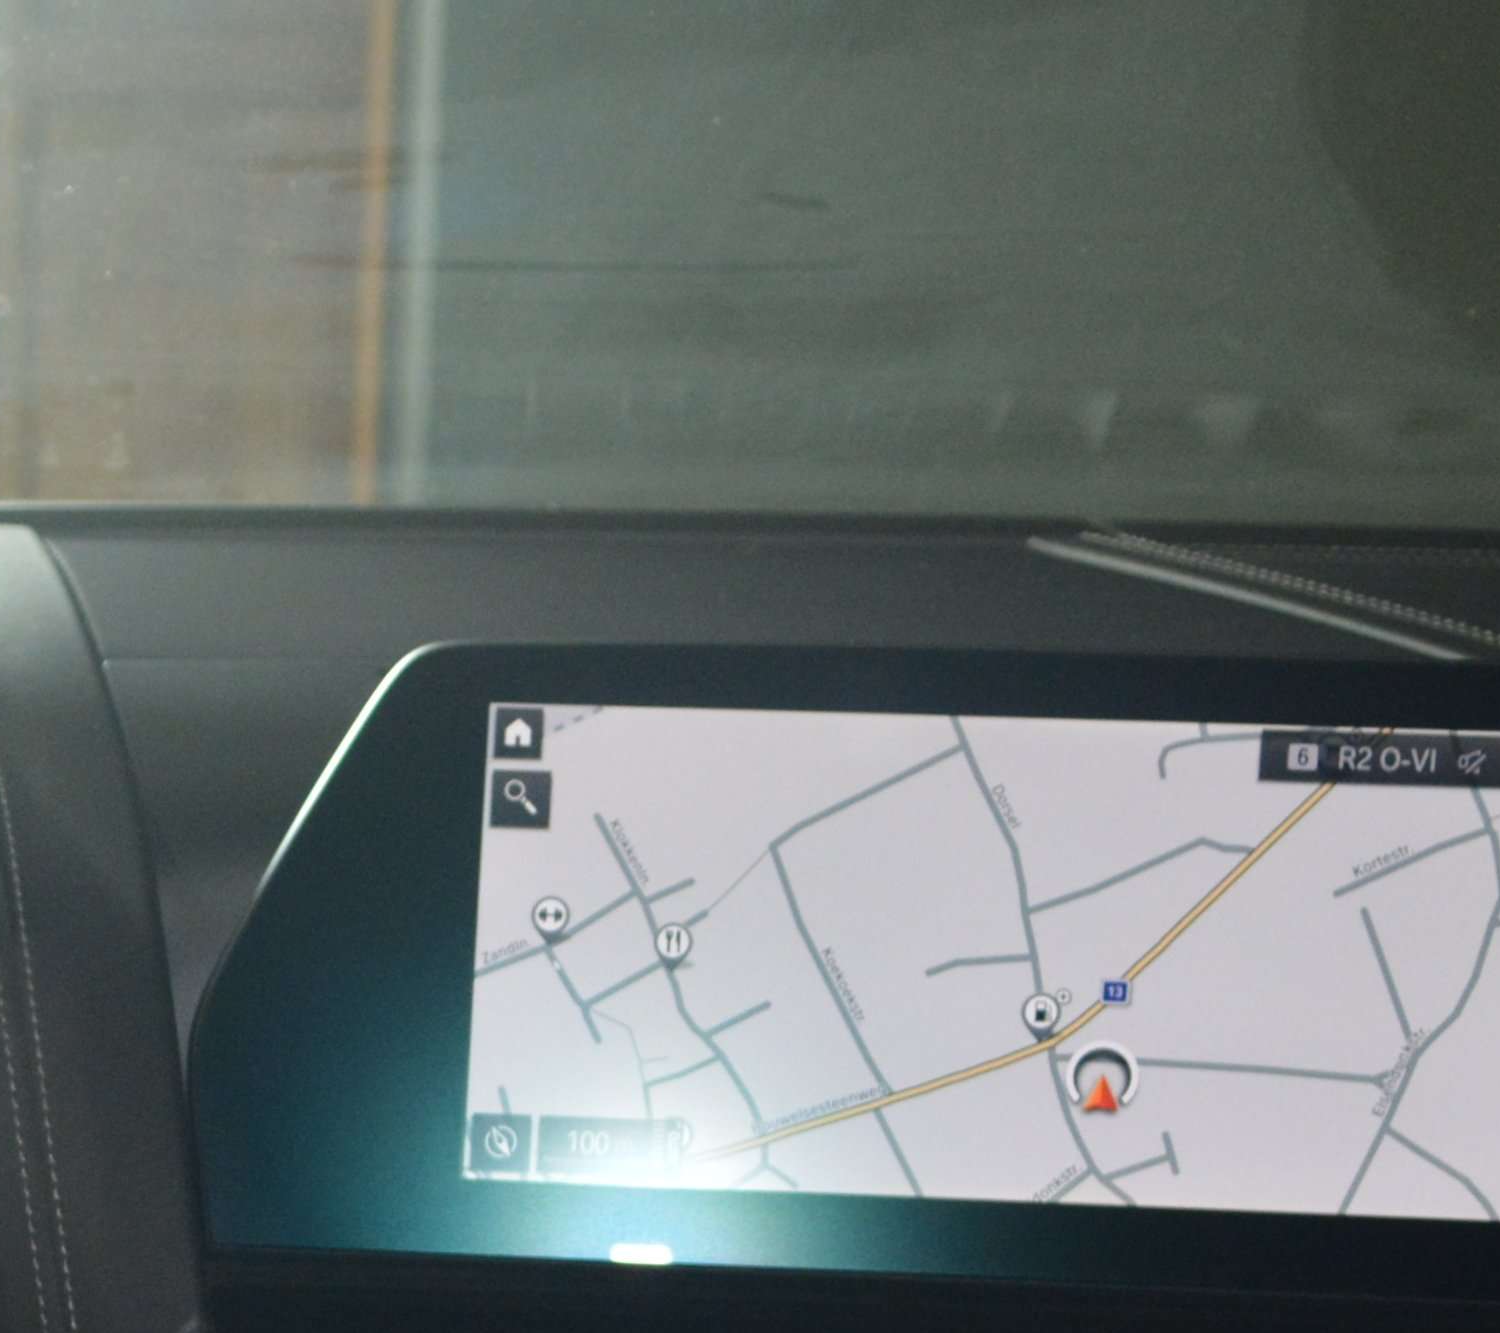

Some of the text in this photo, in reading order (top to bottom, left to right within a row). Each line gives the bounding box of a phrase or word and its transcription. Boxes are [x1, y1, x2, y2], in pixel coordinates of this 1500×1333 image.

[1338, 747, 1436, 773] R2 O-VI
[567, 1129, 609, 1155] 100
